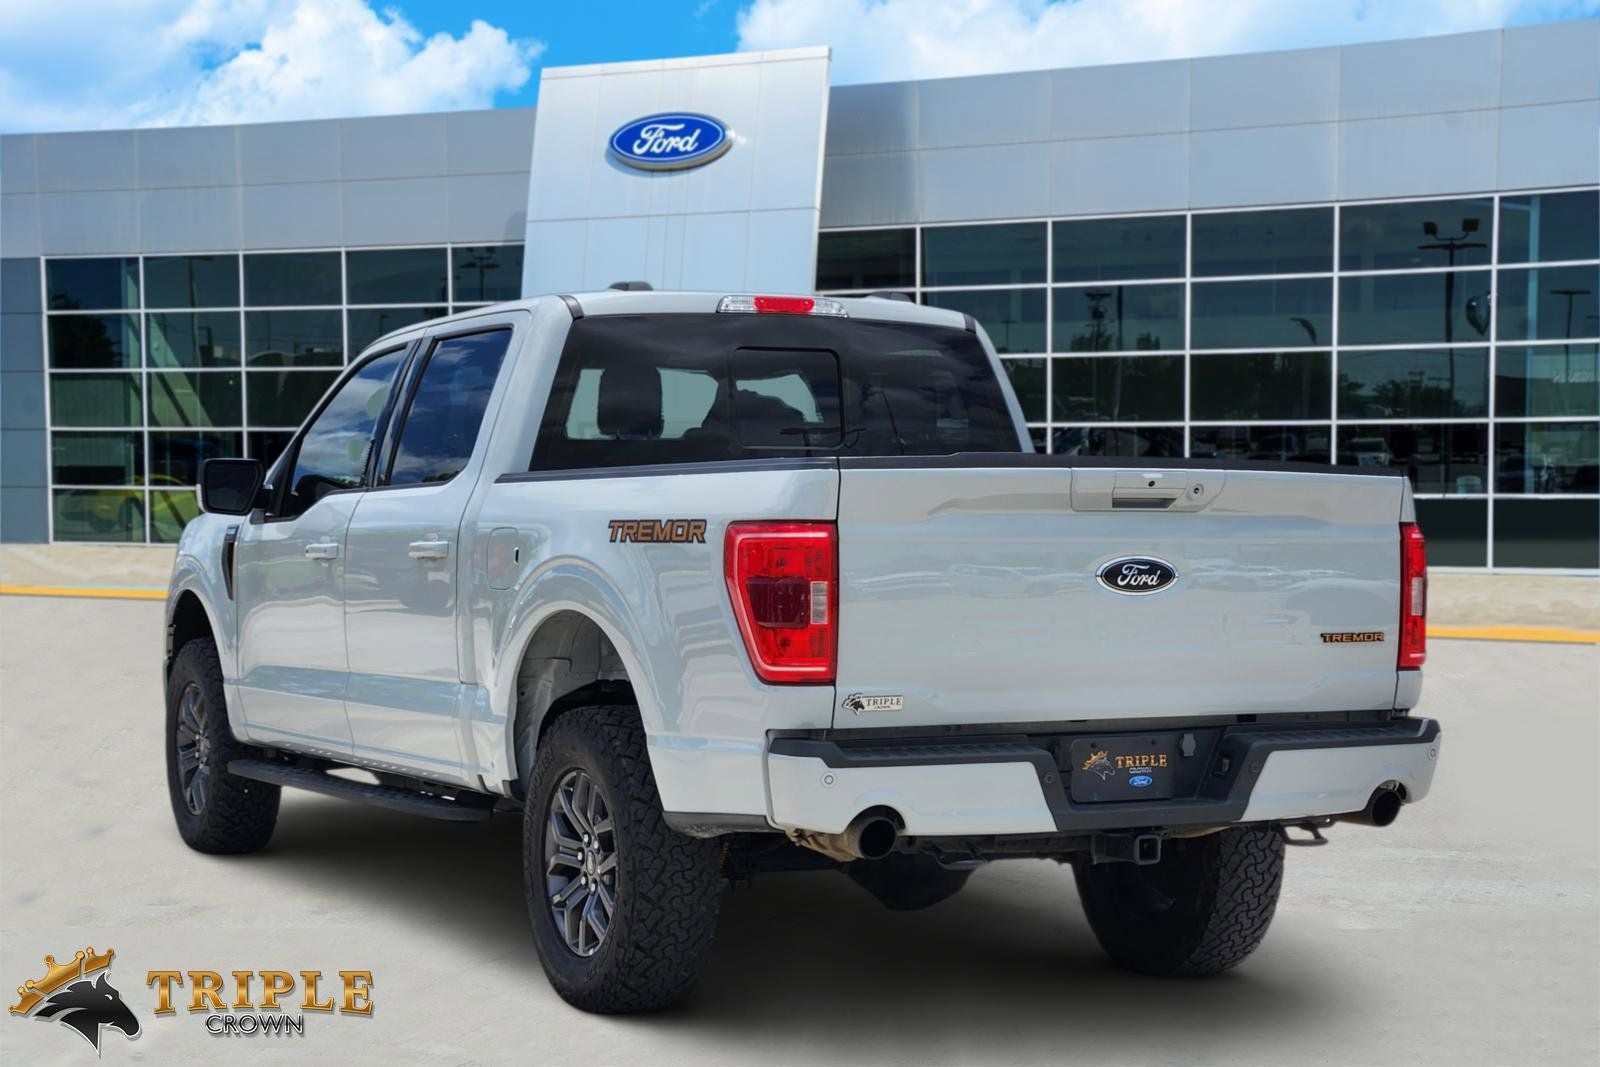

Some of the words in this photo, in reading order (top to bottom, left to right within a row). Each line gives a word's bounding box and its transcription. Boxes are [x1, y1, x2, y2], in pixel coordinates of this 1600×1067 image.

[632, 123, 701, 155] Ford
[608, 519, 707, 544] TREMOR
[1117, 563, 1161, 586] Ford
[1320, 631, 1385, 643] TREMOR
[865, 697, 902, 706] TRIPLE
[1114, 754, 1168, 769] TRIPLE
